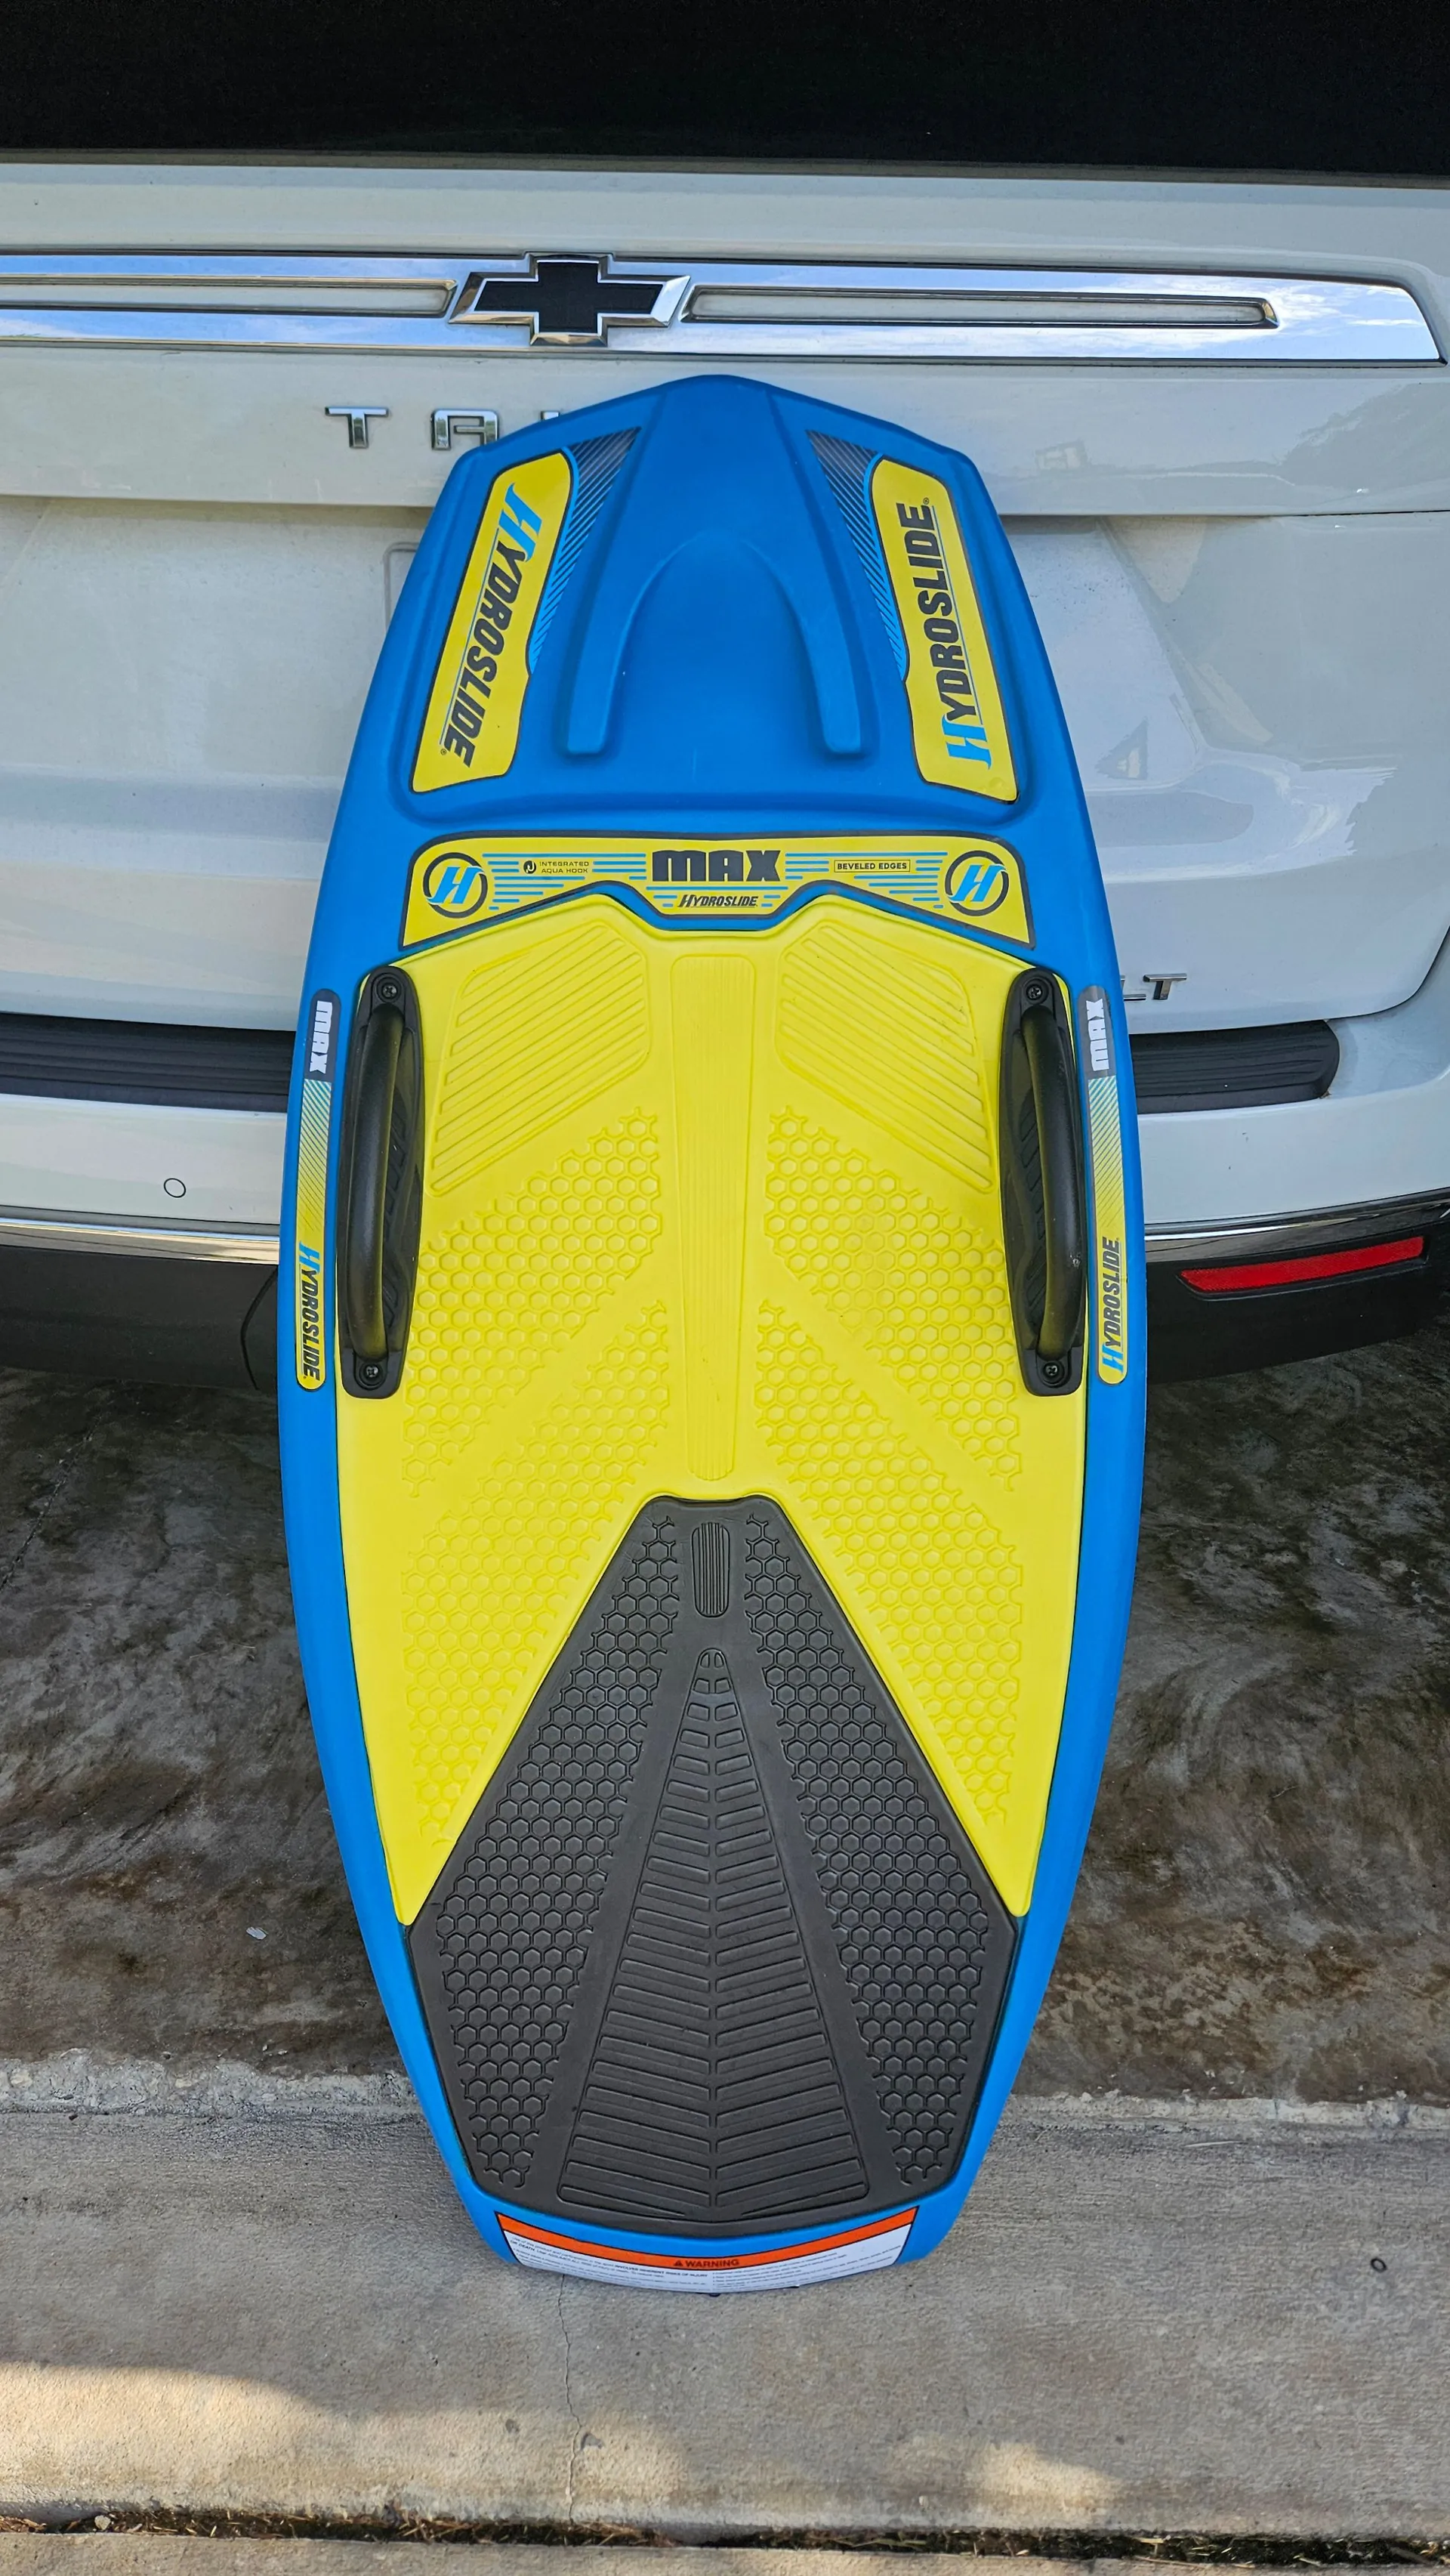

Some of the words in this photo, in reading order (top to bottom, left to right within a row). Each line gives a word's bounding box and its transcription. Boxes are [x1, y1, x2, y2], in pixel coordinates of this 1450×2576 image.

[652, 850, 781, 882] MAX
[677, 894, 758, 907] HYDROSLIDE
[309, 1000, 334, 1073] MAX
[1085, 999, 1109, 1071] MAX
[685, 2259, 739, 2268] WARNING
